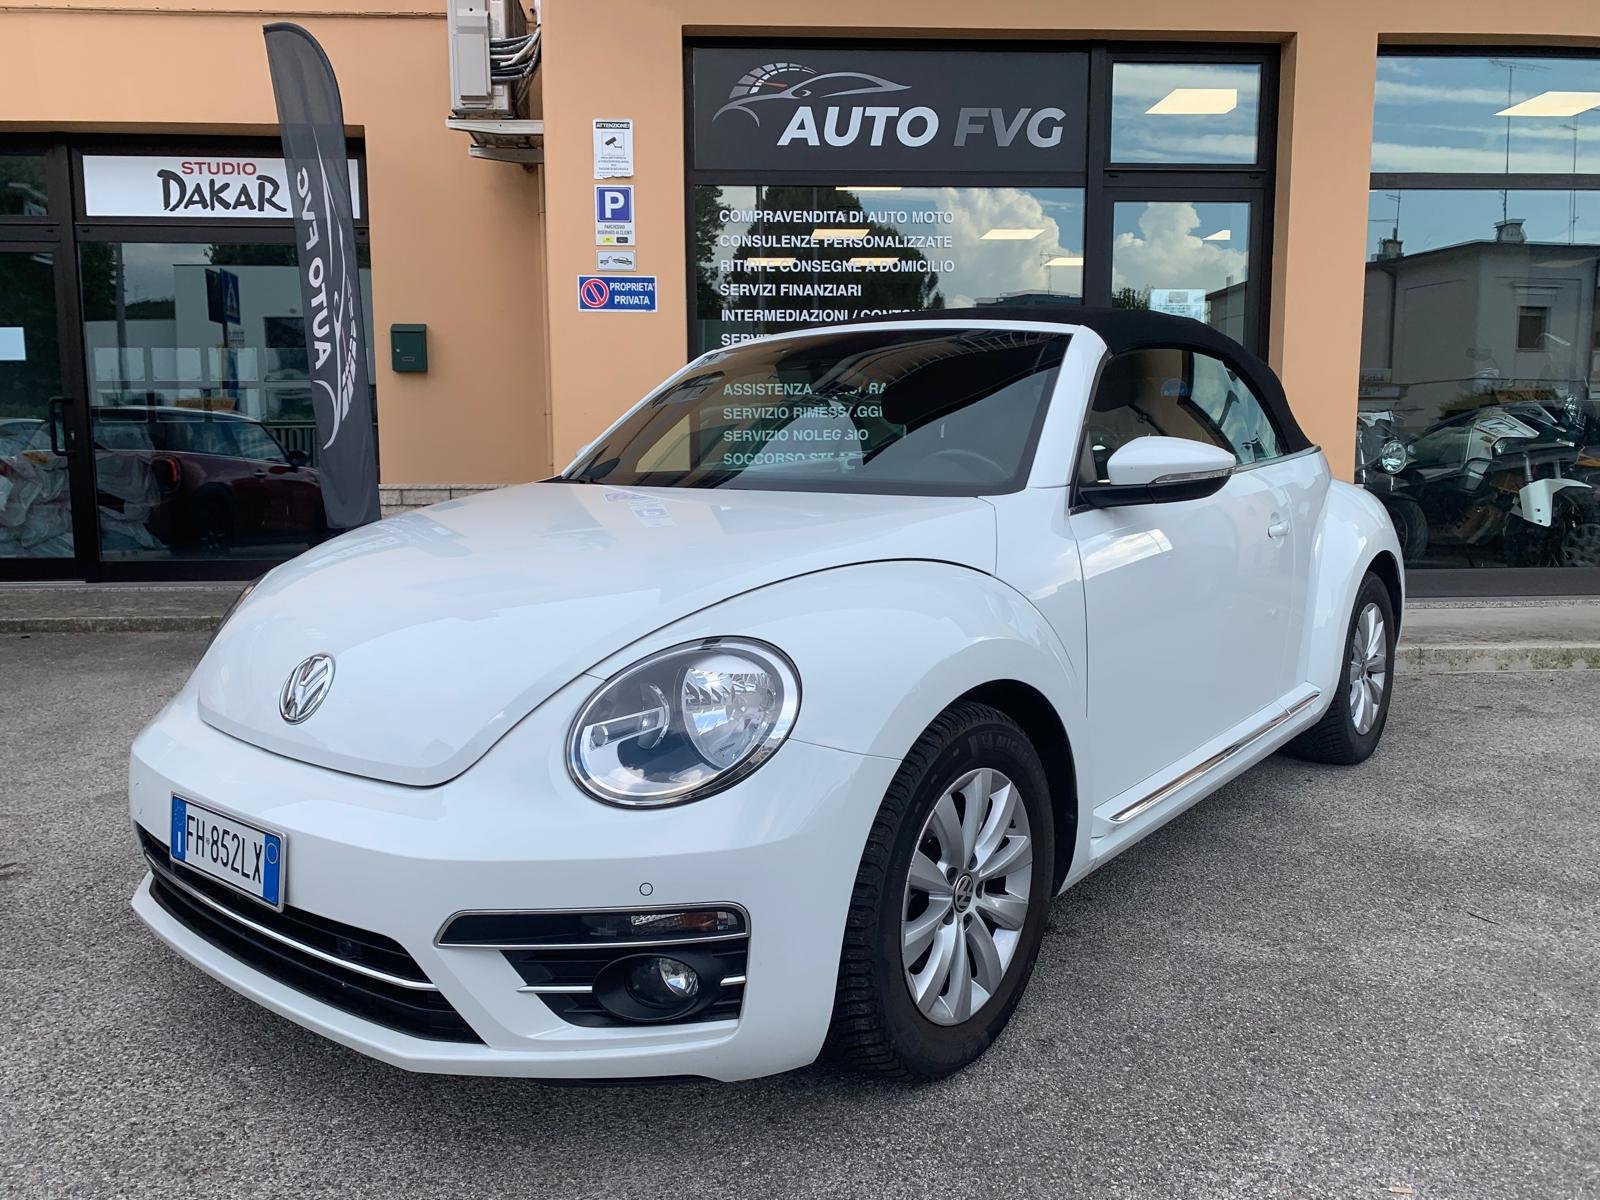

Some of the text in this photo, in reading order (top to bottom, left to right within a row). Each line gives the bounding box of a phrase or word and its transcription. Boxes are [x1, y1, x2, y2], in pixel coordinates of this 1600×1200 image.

[776, 106, 1067, 148] AUTO FVG
[180, 161, 257, 176] STUDIO
[157, 169, 287, 212] DAKAR
[604, 191, 625, 219] P
[719, 210, 955, 224] COMPRAVENDITA DI AUTO MOTO
[719, 235, 953, 248] CONSULENZE PERSONALIZZATE
[720, 260, 955, 272] RITIRI E CONSEGNE A DOMICILIO
[719, 284, 862, 297] SERVIZI FINANZIARI
[614, 295, 650, 305] PRIVATA
[721, 309, 848, 322] INTERMEDIAZIONI
[723, 383, 813, 396] ASSISTENZA
[723, 407, 789, 419] SERVIZIO
[723, 430, 789, 442] SERVIZIO
